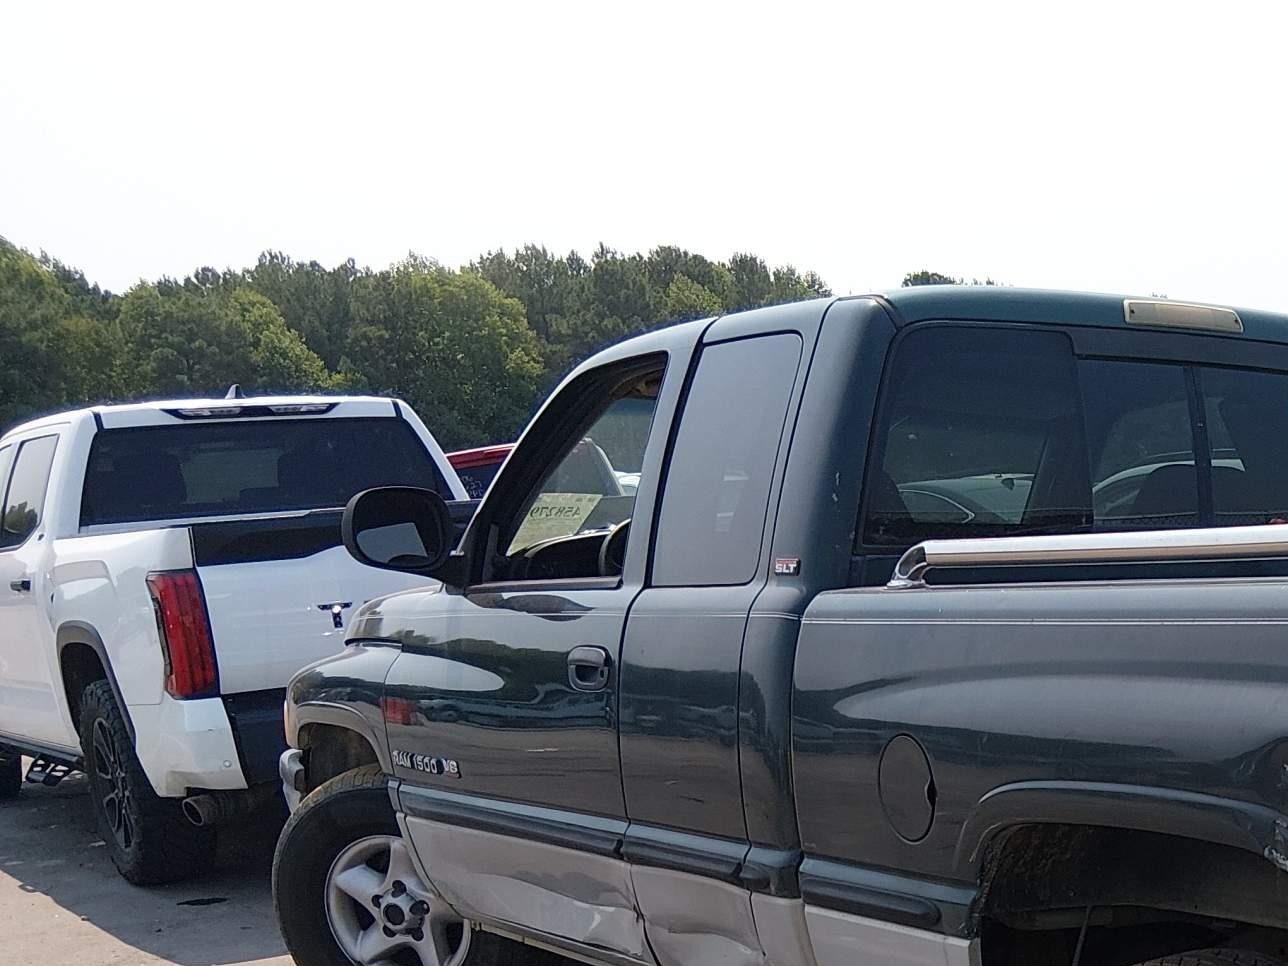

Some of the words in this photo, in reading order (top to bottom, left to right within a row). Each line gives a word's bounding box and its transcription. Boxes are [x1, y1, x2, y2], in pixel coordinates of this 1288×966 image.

[775, 563, 797, 573] SLT
[392, 750, 412, 769] RAM
[412, 754, 438, 774] 1500
[442, 758, 458, 773] V8
